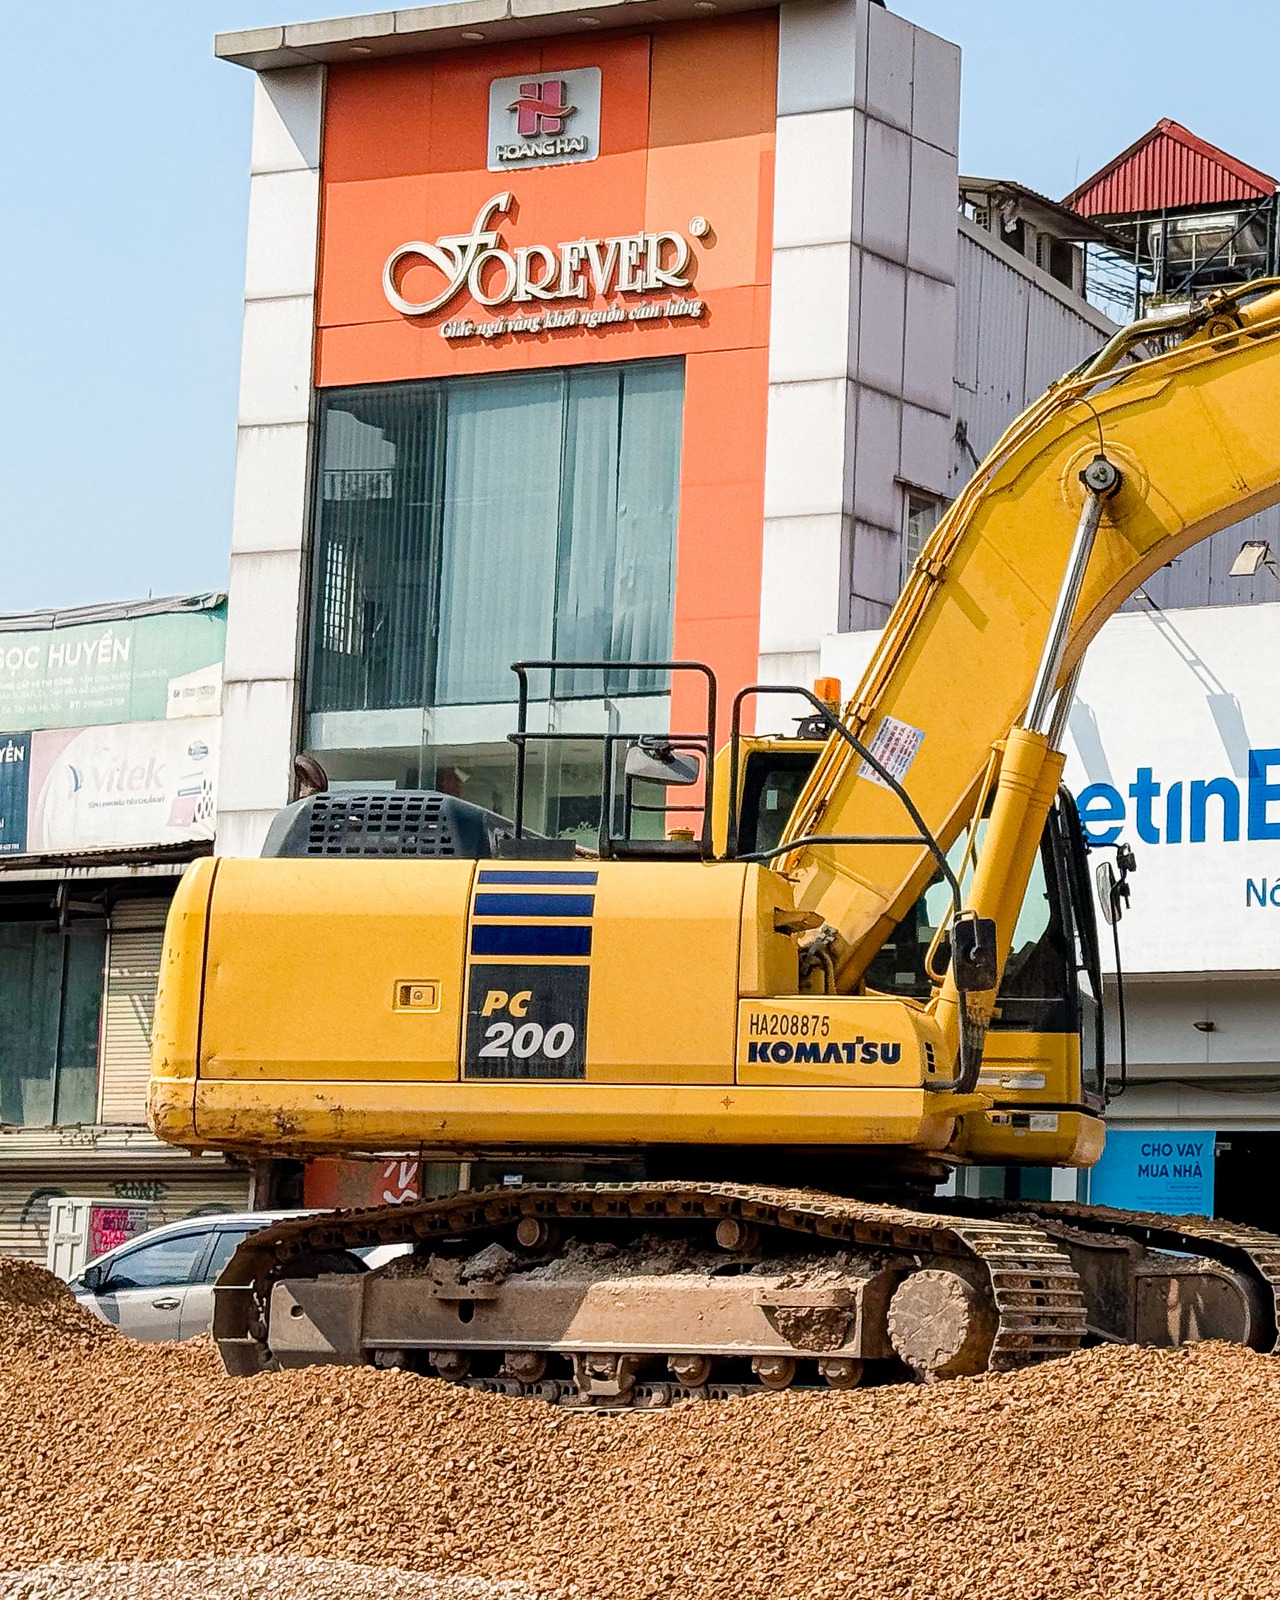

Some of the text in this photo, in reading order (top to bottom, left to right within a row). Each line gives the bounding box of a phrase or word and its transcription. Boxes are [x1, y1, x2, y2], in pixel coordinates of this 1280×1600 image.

[481, 990, 533, 1018] PC
[749, 1014, 830, 1037] HA208875
[478, 1022, 575, 1059] 200
[748, 1036, 901, 1065] KOMATSU
[1141, 1143, 1203, 1157] CHO VAY
[1138, 1161, 1203, 1178] MUA NHÀ
